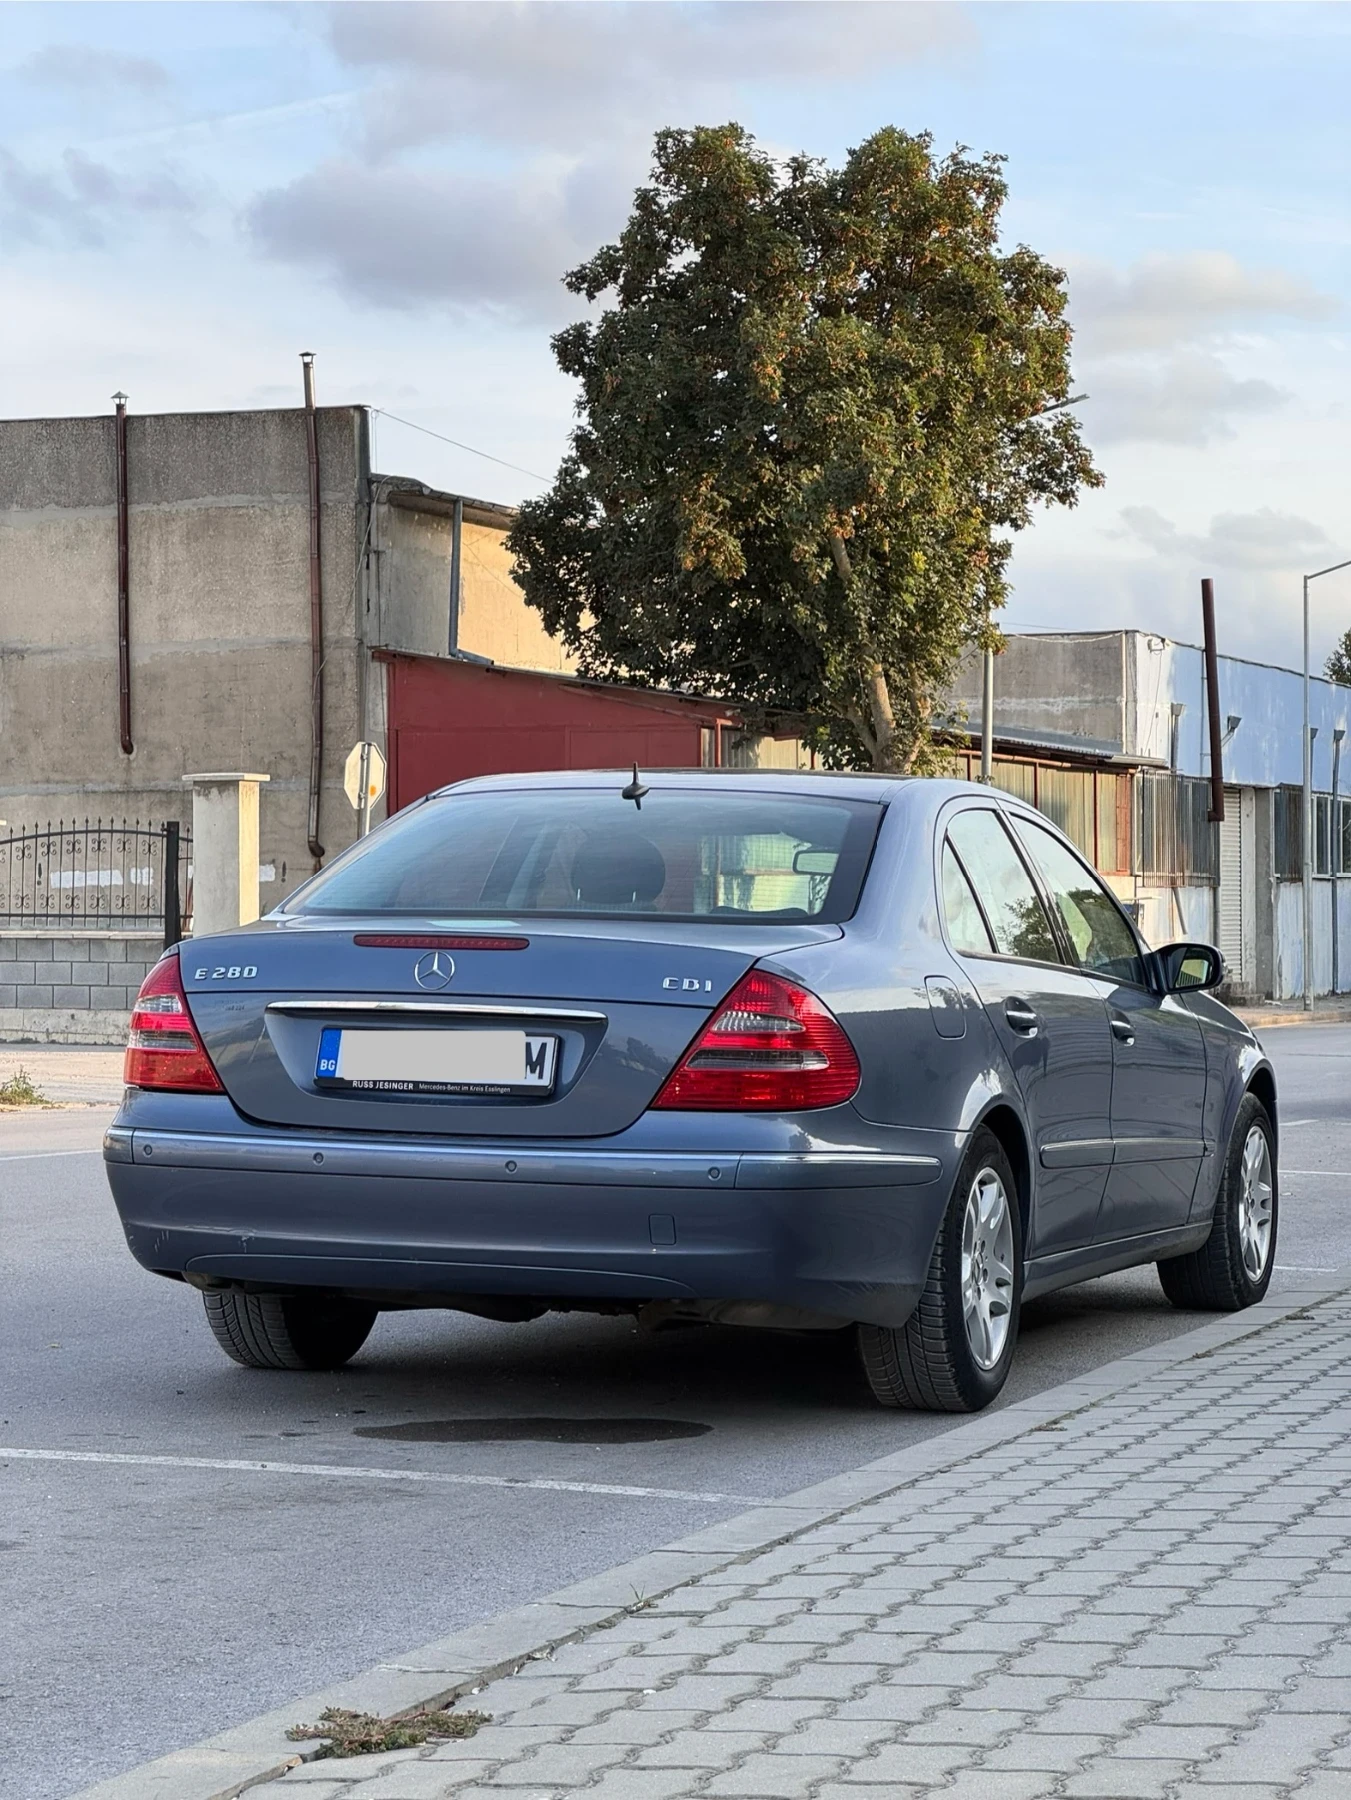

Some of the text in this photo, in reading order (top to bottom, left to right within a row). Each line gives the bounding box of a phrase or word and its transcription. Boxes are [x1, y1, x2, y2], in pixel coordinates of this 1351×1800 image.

[194, 966, 258, 980] E 280
[662, 976, 712, 992] CDI
[319, 1059, 336, 1071] BG
[352, 1080, 374, 1089] RUSS
[375, 1081, 414, 1091] JESINGER
[418, 1083, 461, 1092] Mercedes-Benz
[461, 1084, 469, 1092] im
[485, 1086, 511, 1094] Esslingen
